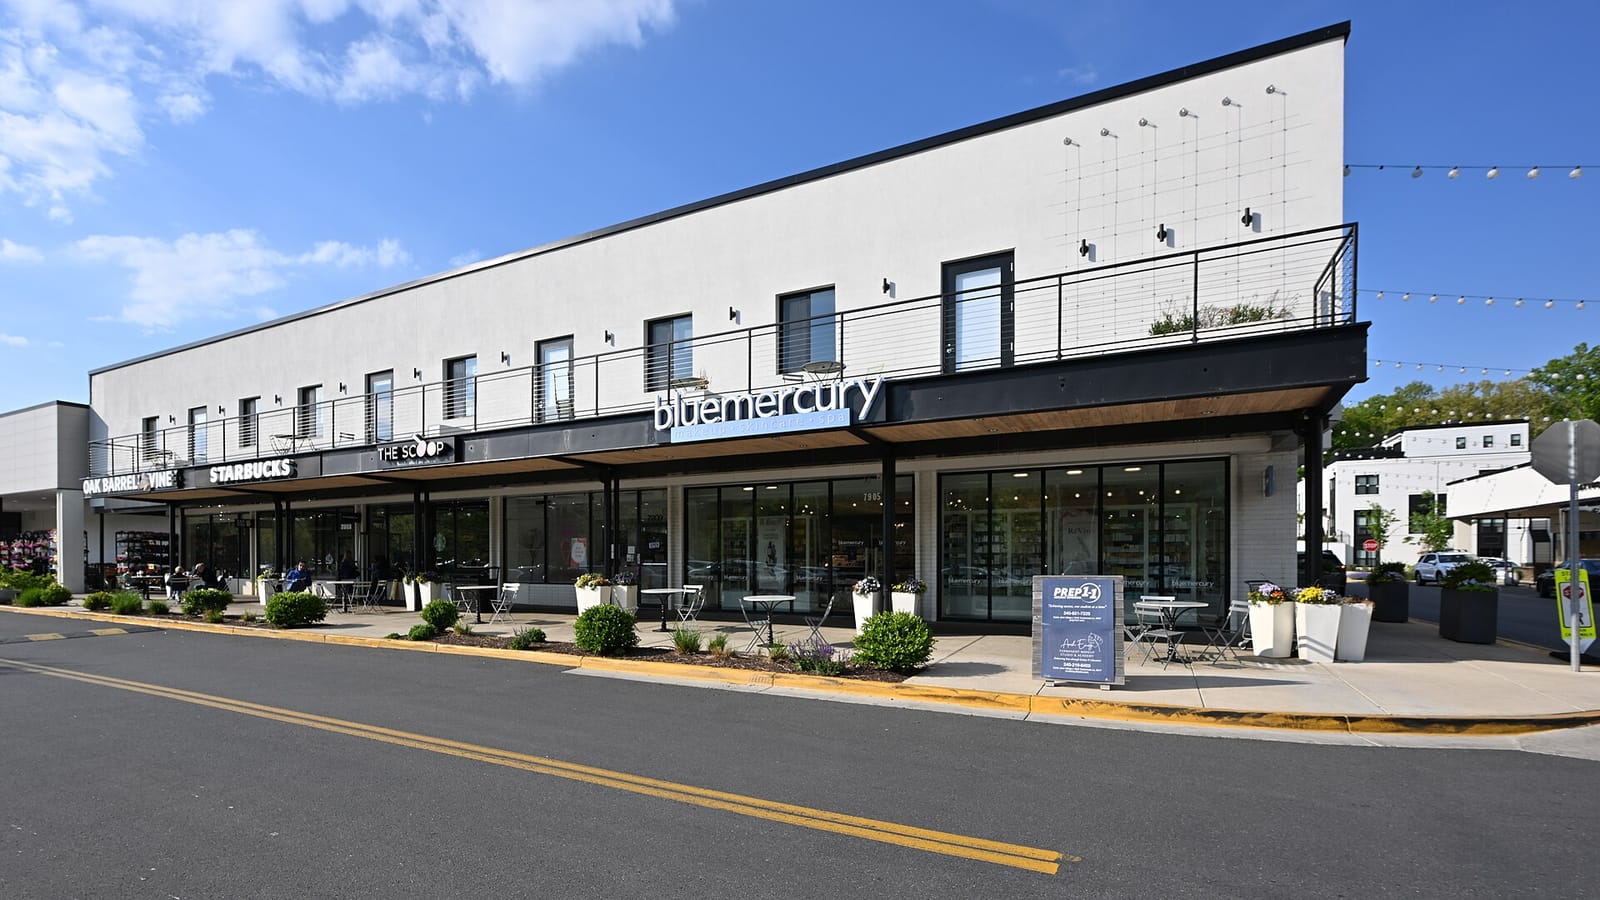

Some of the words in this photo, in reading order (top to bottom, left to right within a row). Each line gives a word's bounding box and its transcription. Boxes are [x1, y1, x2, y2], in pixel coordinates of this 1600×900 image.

[654, 377, 885, 431] bluemercury
[818, 413, 845, 426] spa
[377, 446, 398, 461] THE
[402, 440, 444, 458] SCOOP
[83, 479, 101, 495] OAK
[102, 474, 139, 493] BARREL
[149, 470, 173, 488] VINE
[209, 458, 291, 483] STARBUCKS
